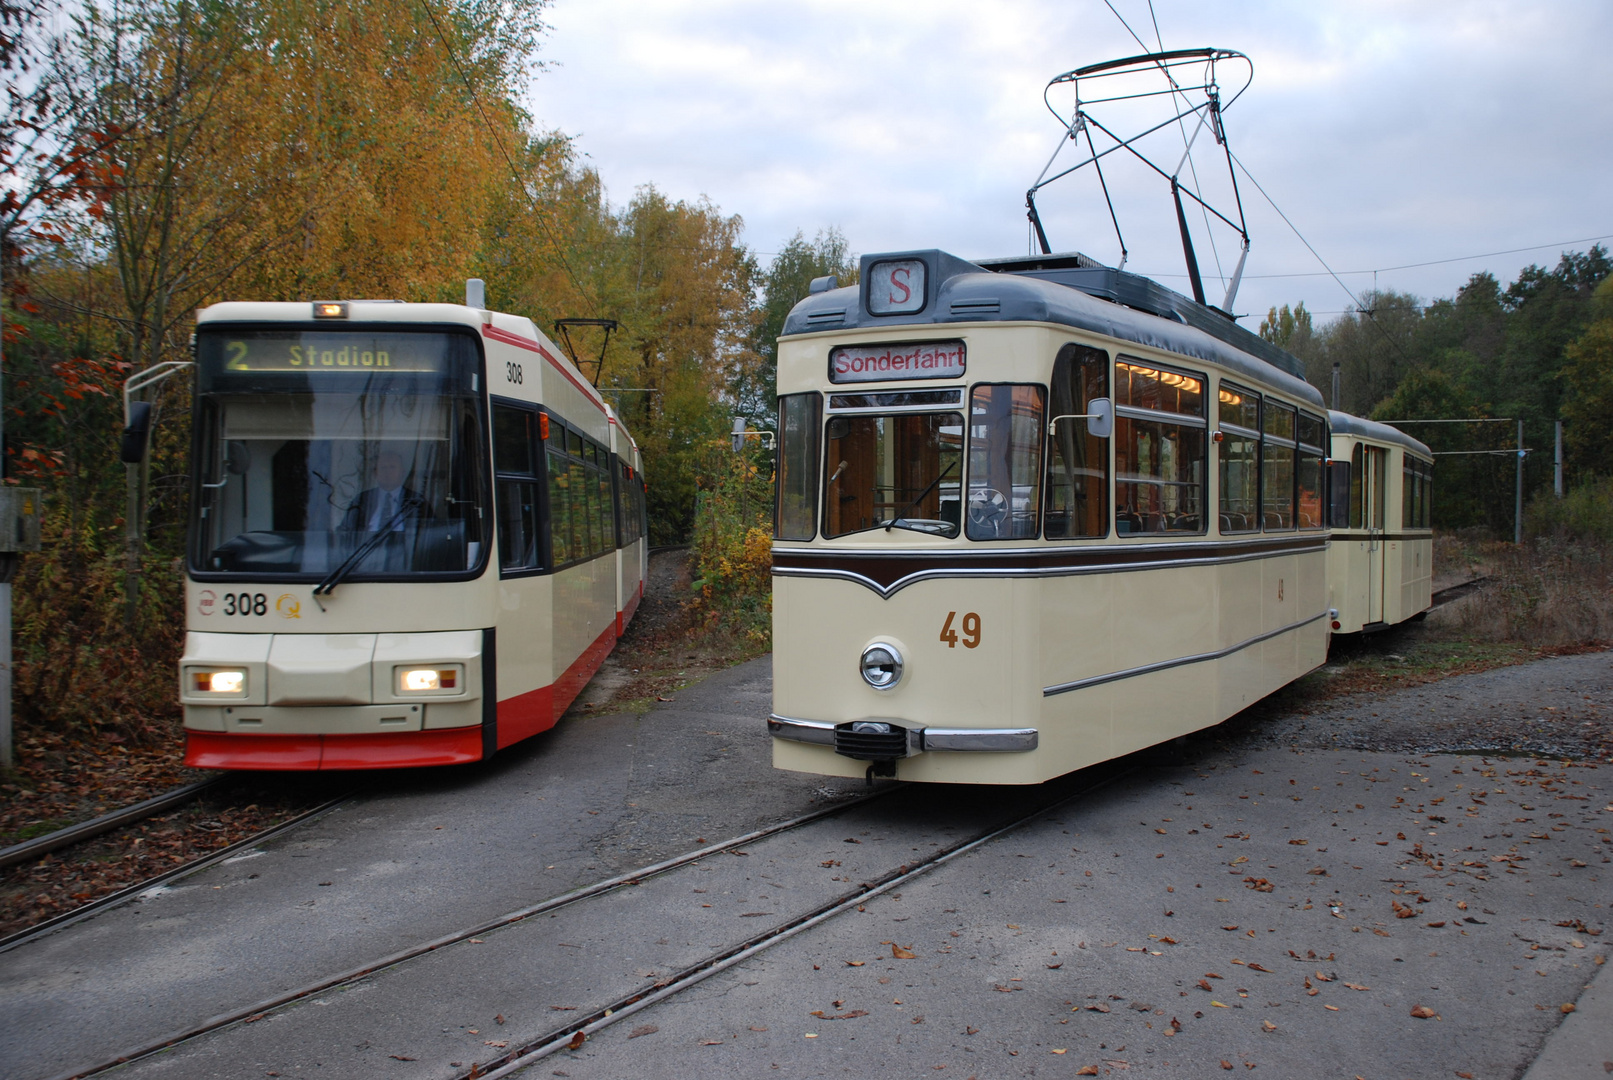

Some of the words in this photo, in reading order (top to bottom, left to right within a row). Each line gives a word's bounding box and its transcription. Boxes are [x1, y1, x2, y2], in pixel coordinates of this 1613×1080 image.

[889, 268, 911, 304] S
[225, 341, 249, 370] 2
[289, 345, 390, 366] Stadion
[835, 346, 965, 374] Sonderfahrt
[506, 361, 523, 385] 308
[223, 593, 268, 616] 308
[939, 611, 982, 649] 49
